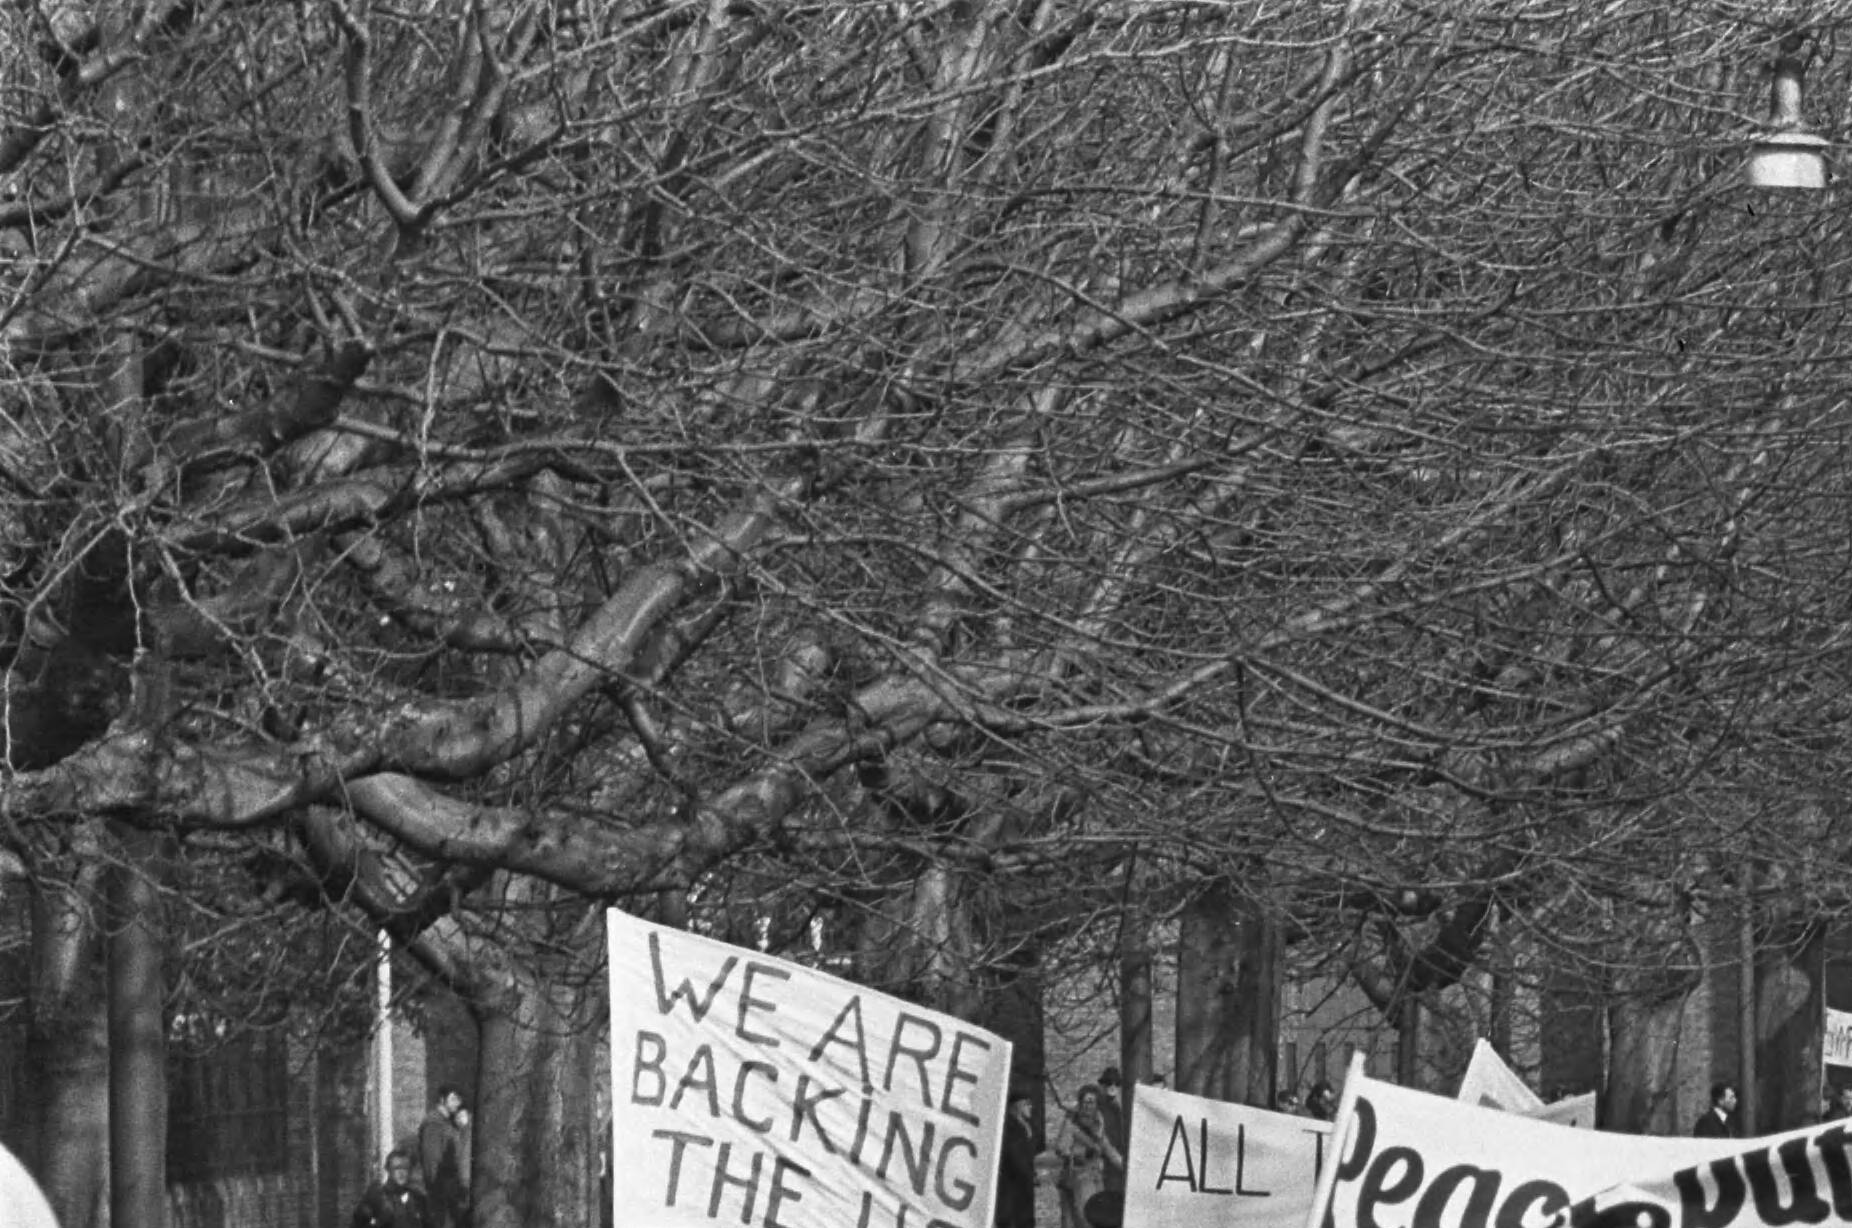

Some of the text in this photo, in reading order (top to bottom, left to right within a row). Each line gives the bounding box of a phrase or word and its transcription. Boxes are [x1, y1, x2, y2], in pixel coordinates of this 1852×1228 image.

[648, 931, 991, 1127] WE ARE
[631, 1030, 977, 1213] BACKING
[1156, 1115, 1270, 1197] ALL
